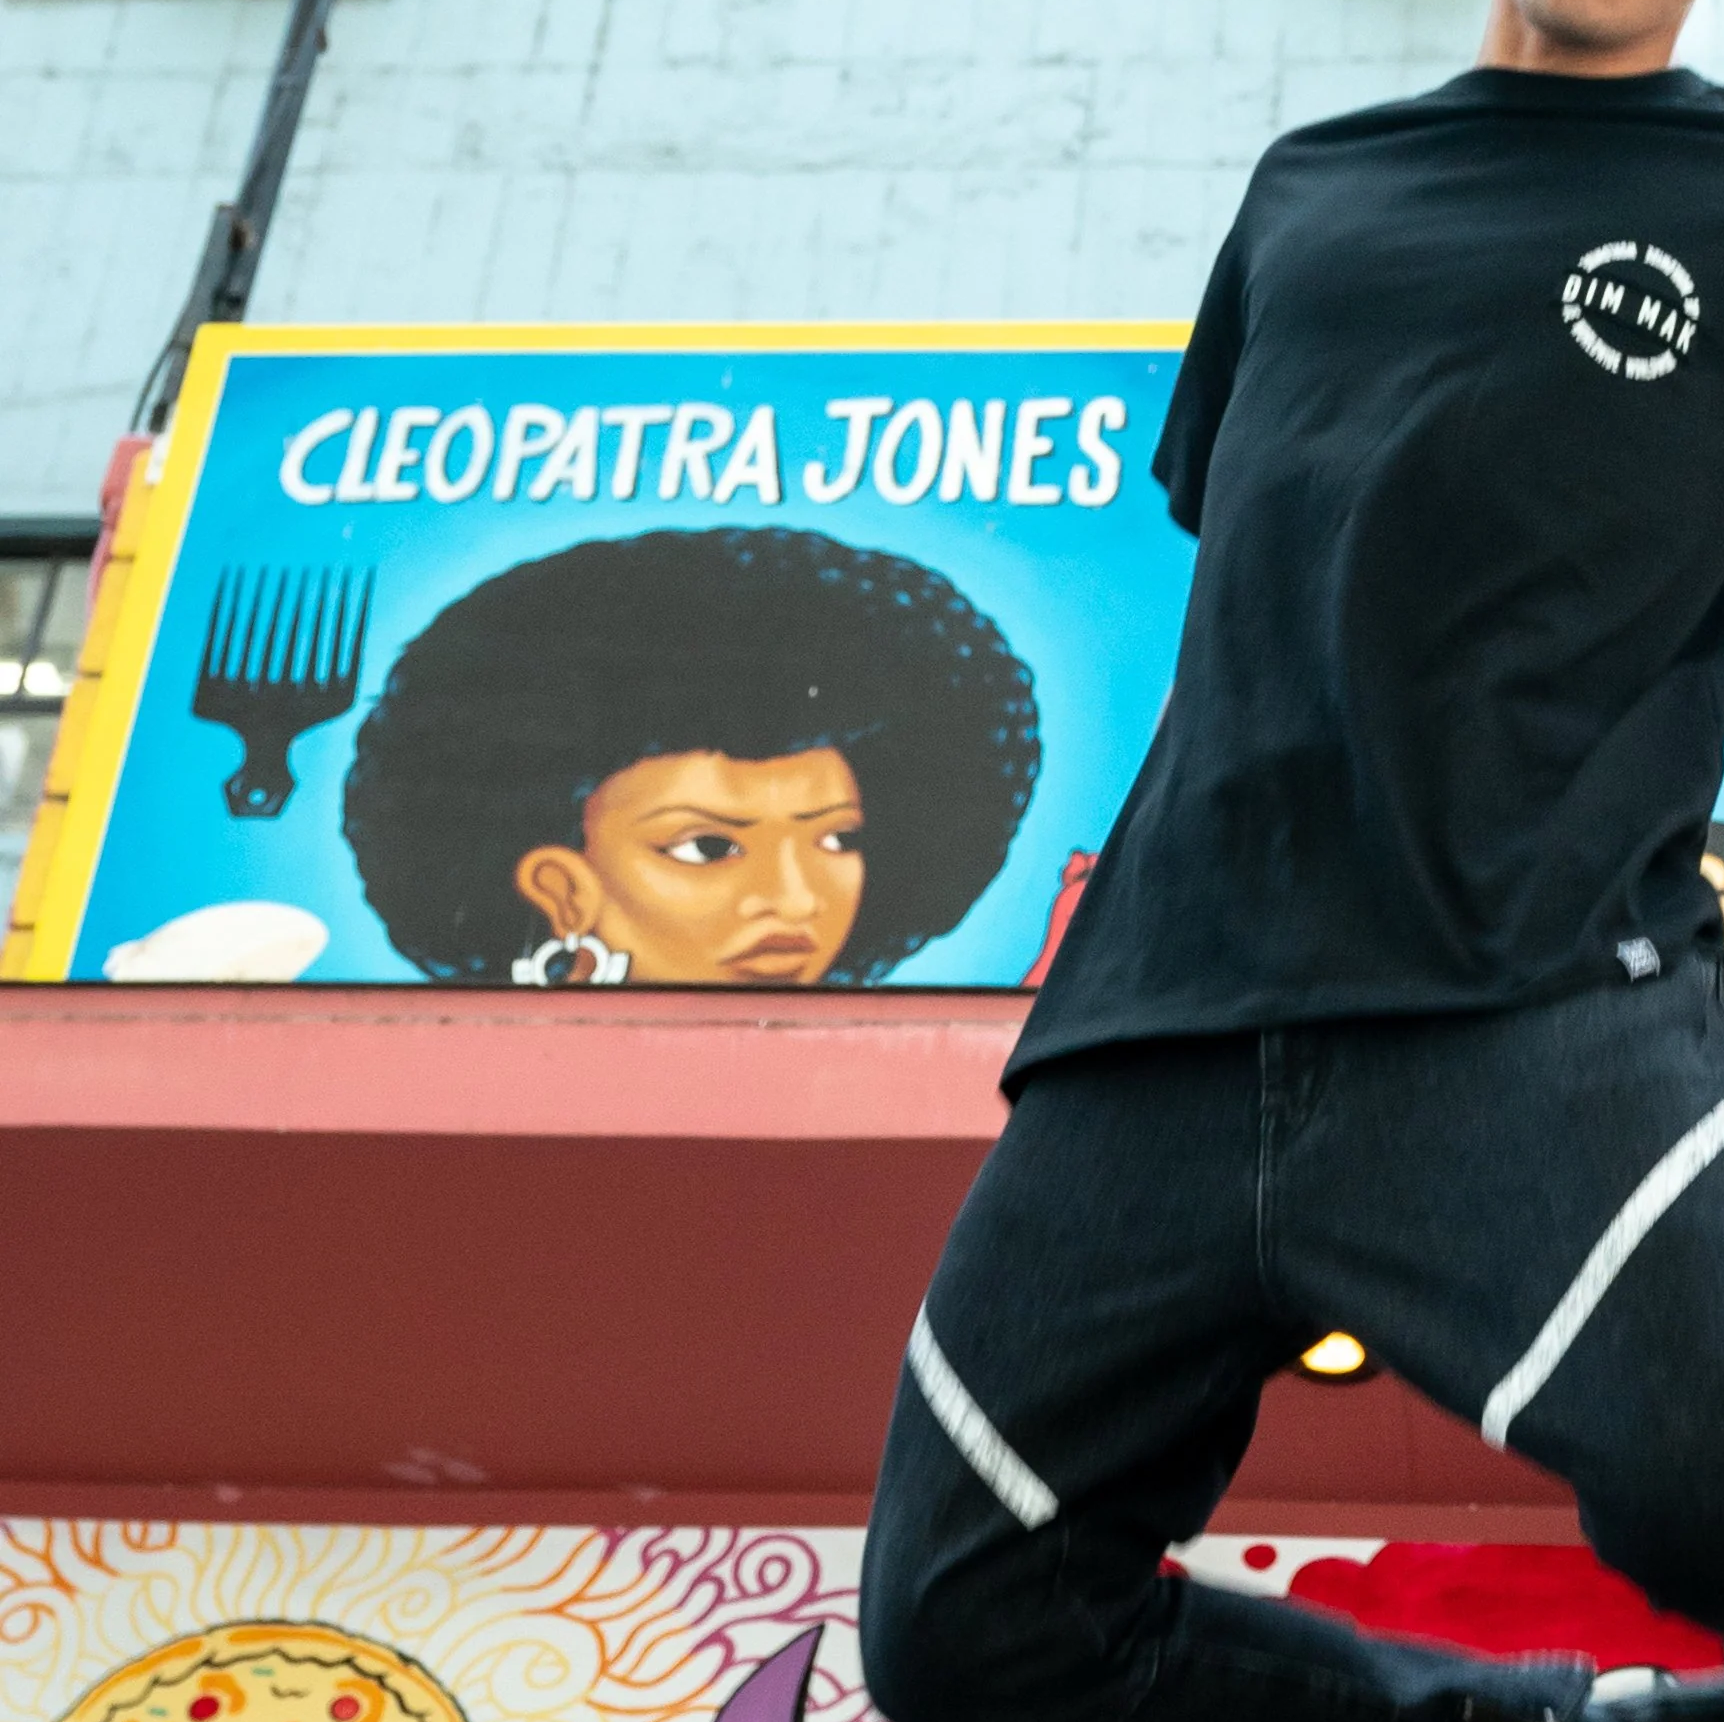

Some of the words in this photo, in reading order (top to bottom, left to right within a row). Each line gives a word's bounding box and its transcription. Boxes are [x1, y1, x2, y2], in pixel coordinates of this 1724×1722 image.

[1561, 274, 1626, 315] DIM
[1636, 295, 1697, 355] MAK
[279, 402, 782, 506] CLEOPATRA
[804, 396, 1127, 508] JONES
